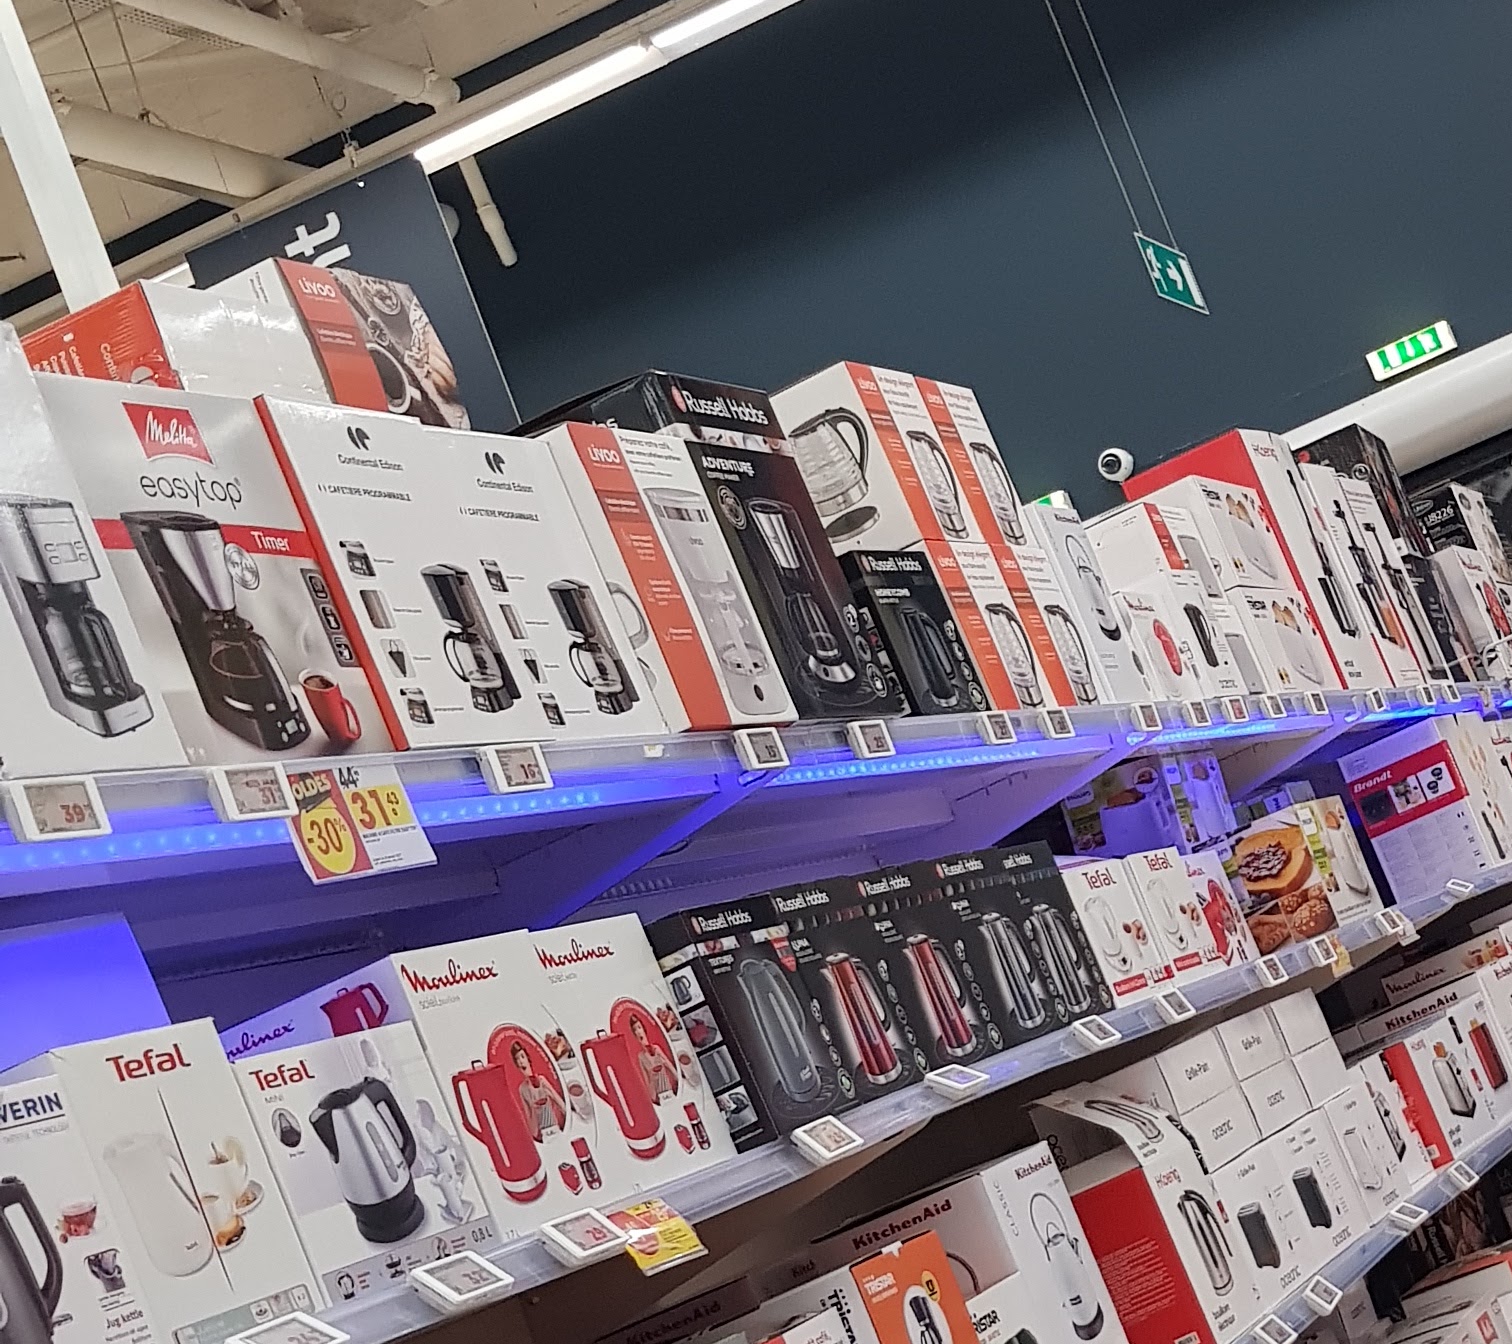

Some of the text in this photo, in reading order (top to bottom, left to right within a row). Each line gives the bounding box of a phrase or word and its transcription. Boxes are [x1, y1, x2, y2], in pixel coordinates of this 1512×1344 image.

[100, 341, 120, 381] Contin
[683, 390, 770, 426] Russell Hobbs
[145, 411, 198, 449] Melitta
[701, 455, 756, 478] ADVENTURE
[140, 472, 243, 510] easytop
[250, 532, 292, 552] Timer
[867, 556, 923, 573] Russell Hobbs
[292, 772, 330, 801] OLDES
[1352, 769, 1394, 795] Brandt
[350, 789, 392, 830] 31
[306, 817, 348, 856] -30%
[941, 857, 985, 877] Russell Hobbs
[1143, 850, 1174, 873] Tefal
[864, 874, 912, 896] Russell Hobbs
[1082, 867, 1118, 891] Tefal
[775, 889, 830, 914] Russell Hobbs
[699, 908, 753, 933] Russell Hobbs
[534, 937, 616, 971] Moulinex
[399, 958, 500, 995] Moulinex
[1385, 991, 1459, 1031] KitchenAid
[226, 1019, 297, 1061] ulinex
[106, 1042, 192, 1083] Tefal
[248, 1058, 316, 1092] Tefal
[0, 1091, 64, 1125] VERIN
[1014, 1154, 1054, 1182] KitchenAid
[851, 1198, 954, 1251] KitchenAid
[971, 1308, 1002, 1335] RISTAR
